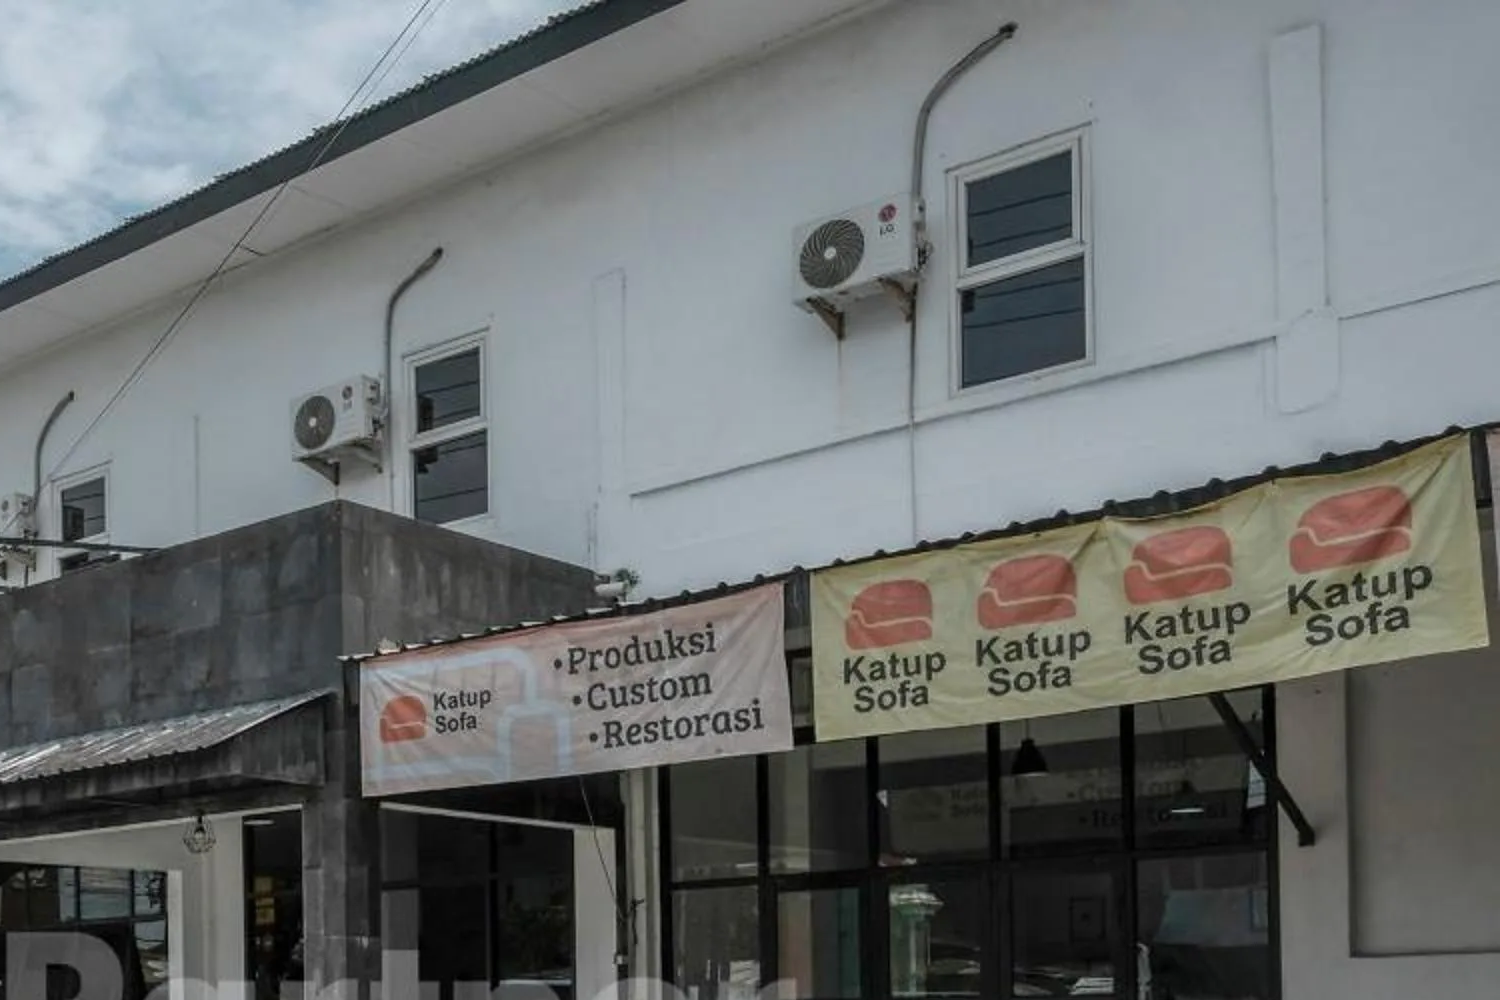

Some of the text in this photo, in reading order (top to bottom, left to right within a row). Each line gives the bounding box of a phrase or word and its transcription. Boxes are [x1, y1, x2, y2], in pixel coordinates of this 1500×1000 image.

[1287, 563, 1433, 616] Katup
[1124, 601, 1251, 645] Katup
[1305, 604, 1411, 647] Sofa
[567, 622, 717, 676] Produksi
[843, 646, 948, 685] Katup
[974, 626, 1092, 668] Katup
[1137, 635, 1233, 675] Sofa
[432, 687, 492, 713] Katup
[587, 671, 713, 711] Custom
[853, 682, 931, 714] Sofa
[987, 664, 1073, 697] Sofa
[434, 713, 478, 735] Sofa
[602, 699, 765, 749] Restorasi
